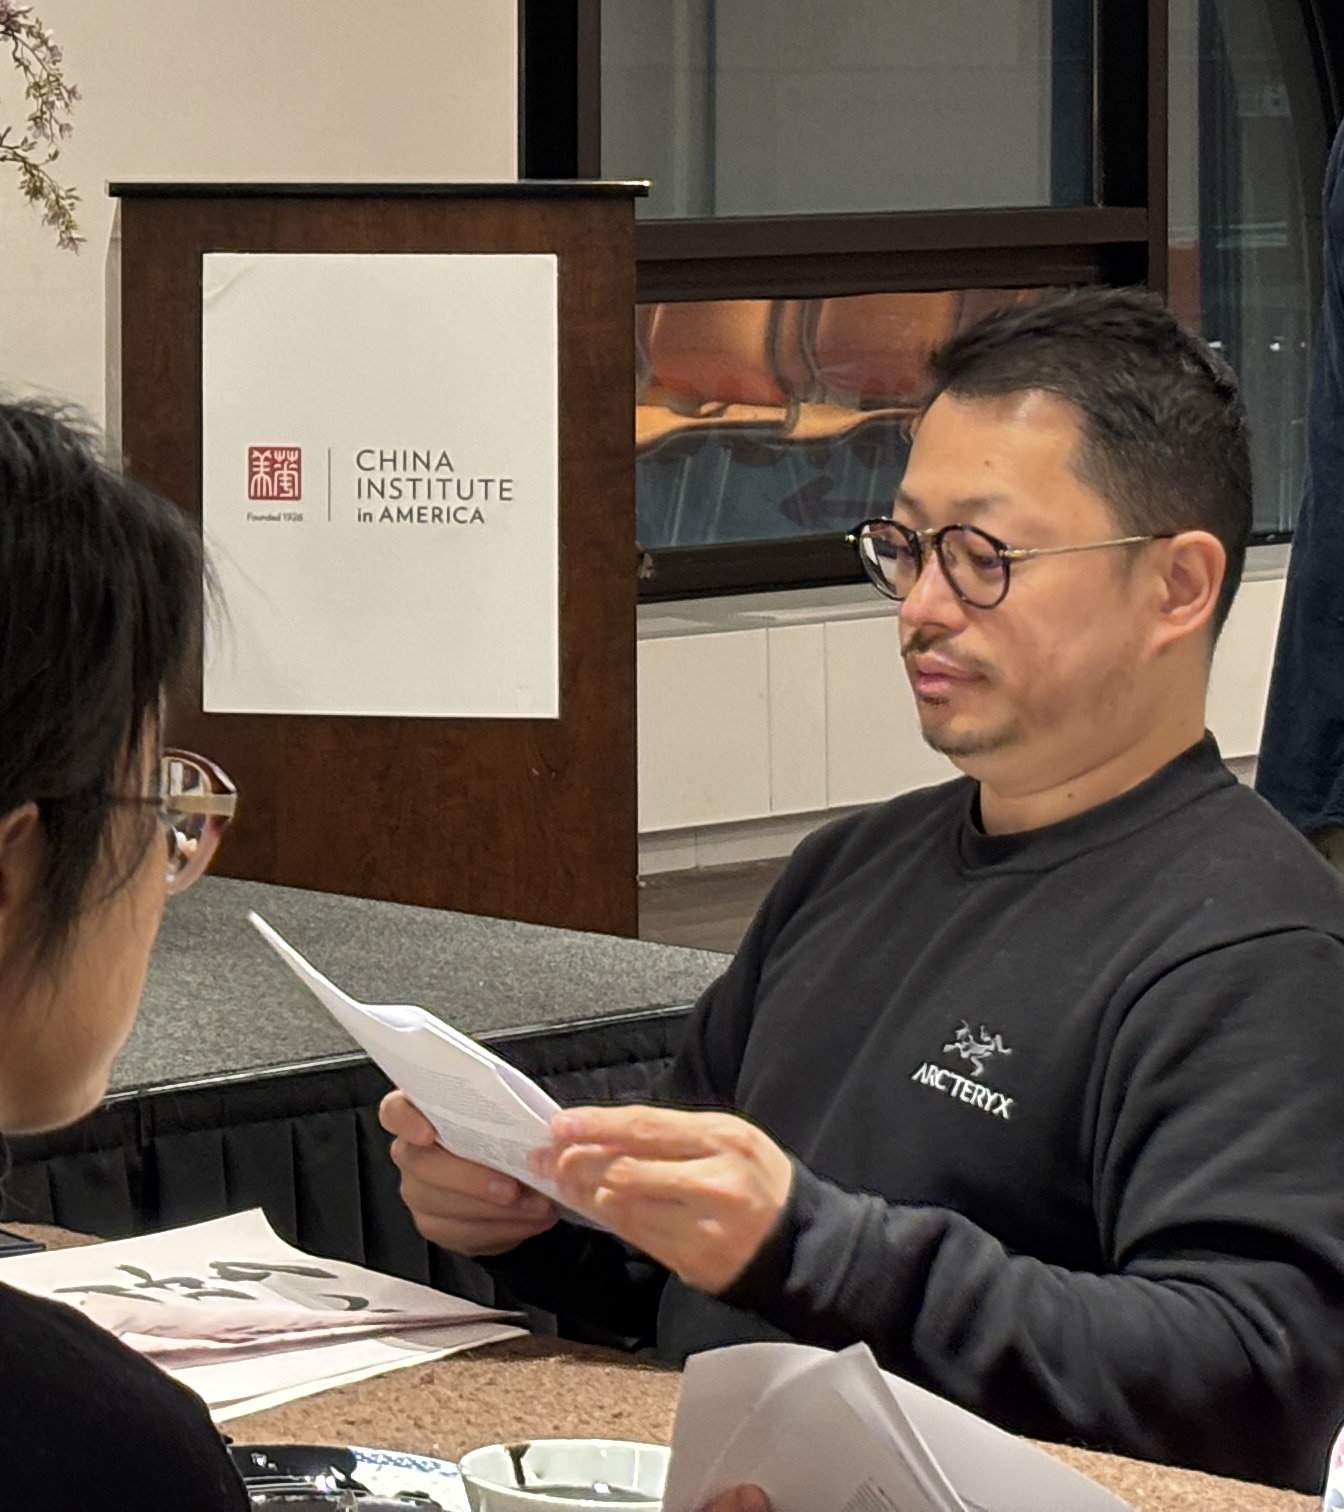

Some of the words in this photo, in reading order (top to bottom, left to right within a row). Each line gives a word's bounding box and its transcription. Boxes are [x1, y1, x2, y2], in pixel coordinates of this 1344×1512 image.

[356, 449, 454, 473] CHINA
[357, 477, 513, 502] INSTITUTE
[357, 507, 373, 524] in
[378, 505, 486, 525] AMERICA
